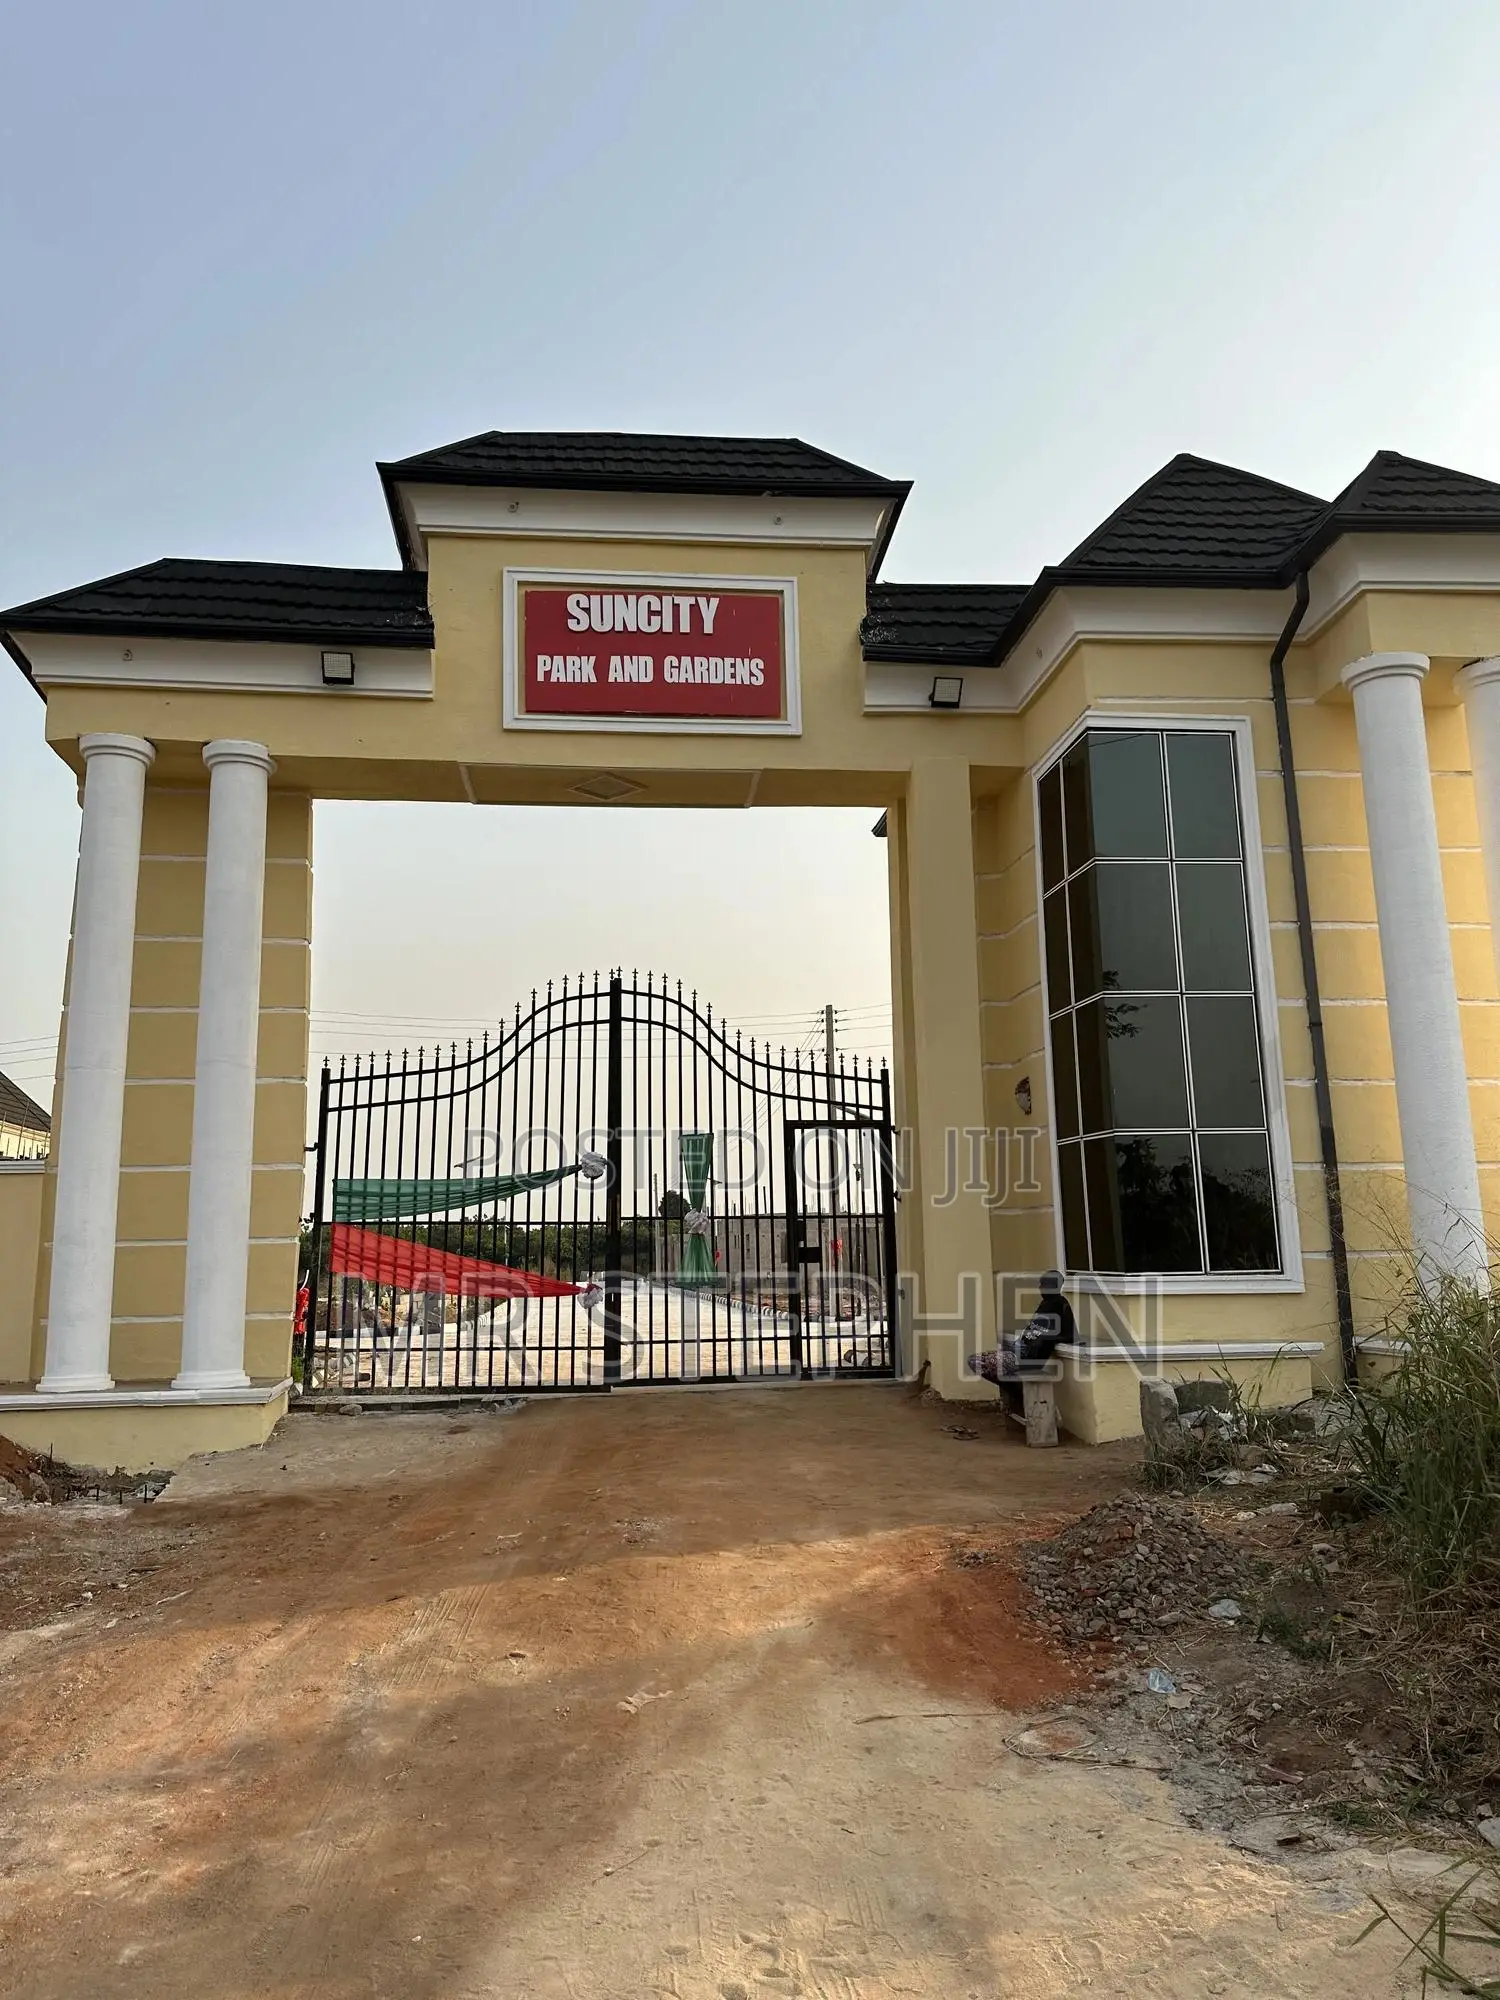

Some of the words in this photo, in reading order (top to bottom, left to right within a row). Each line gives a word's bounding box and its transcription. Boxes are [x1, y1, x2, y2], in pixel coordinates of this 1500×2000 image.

[566, 593, 720, 634] SUNCITY
[536, 654, 597, 683] PARK
[608, 655, 654, 683] AND
[663, 655, 766, 686] GARDENS
